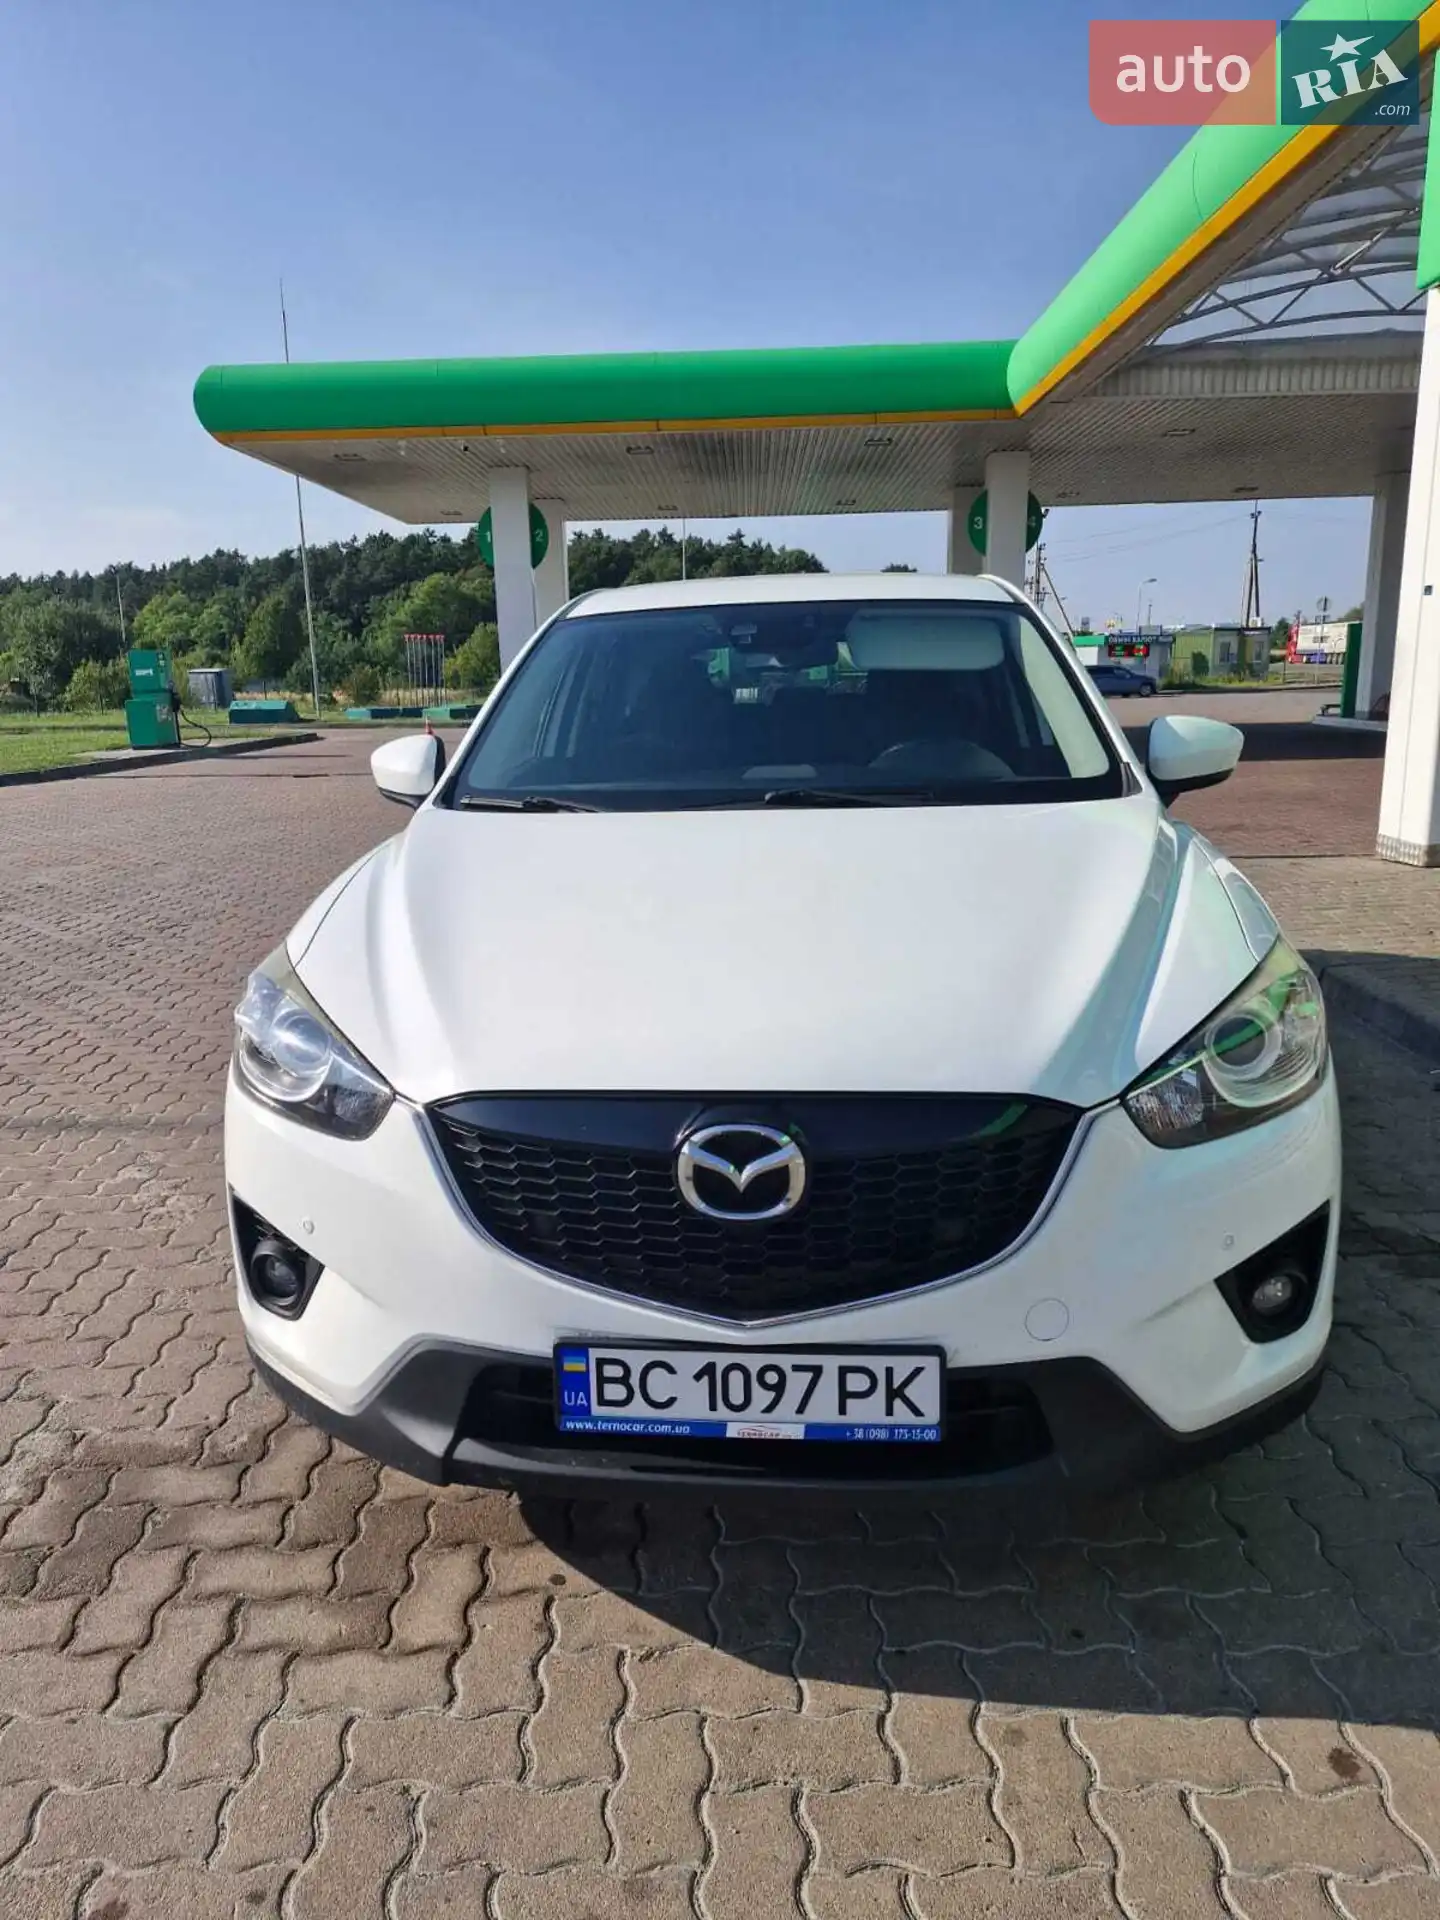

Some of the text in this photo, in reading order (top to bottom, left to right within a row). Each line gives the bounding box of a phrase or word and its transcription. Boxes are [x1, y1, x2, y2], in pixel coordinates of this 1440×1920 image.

[973, 516, 983, 529] 3
[486, 531, 492, 543] 1
[535, 529, 543, 542] 2
[595, 1357, 926, 1417] BC 1097 PK
[564, 1391, 588, 1407] UA
